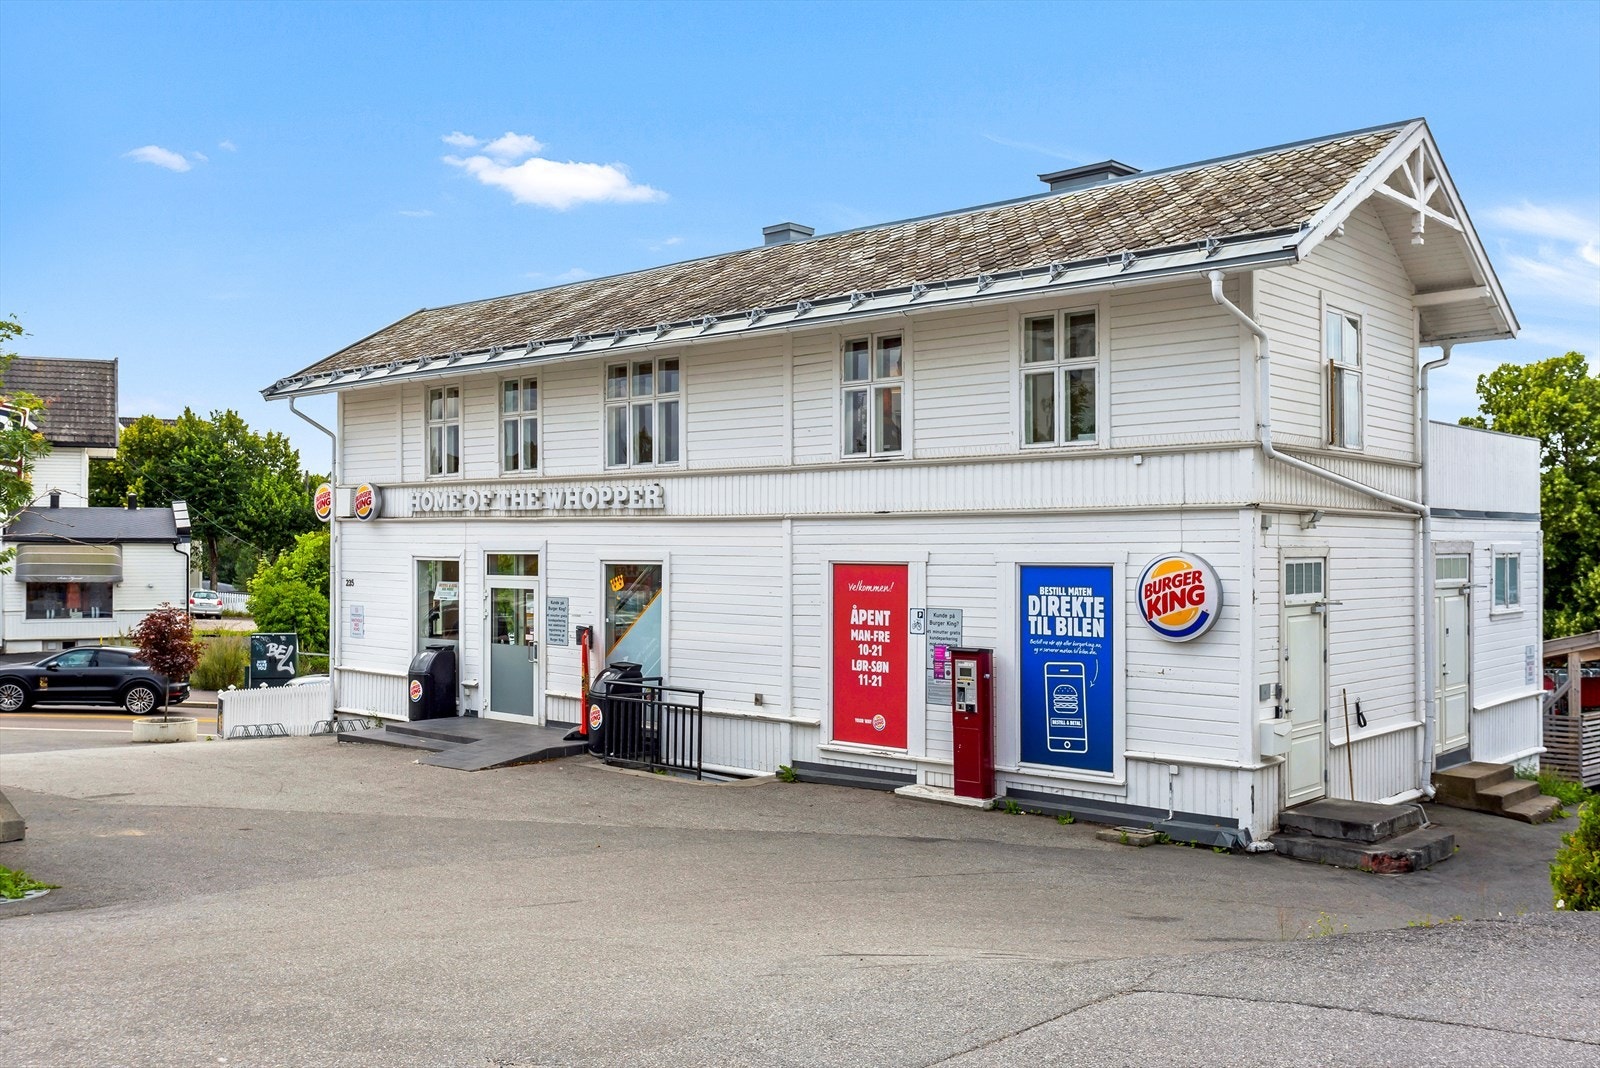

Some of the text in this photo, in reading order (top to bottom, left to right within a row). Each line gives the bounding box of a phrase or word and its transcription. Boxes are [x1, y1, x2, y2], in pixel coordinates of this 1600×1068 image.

[355, 490, 372, 502] BURGER
[410, 484, 664, 512] HOME OF THE WHOPPER
[316, 497, 331, 512] KING
[356, 497, 372, 512] KING
[1040, 586, 1092, 596] BESTILL MATEN
[1144, 570, 1203, 600] BURGER
[1028, 595, 1104, 618] DIREKTE
[1146, 584, 1206, 620] KING
[850, 604, 890, 626] ÅPENT
[1028, 616, 1104, 638] TIL BILEN
[850, 629, 890, 642] MAN-FRE
[858, 644, 882, 656] 10-21
[852, 659, 890, 673] LØR-SØN
[858, 674, 882, 687] 11-21
